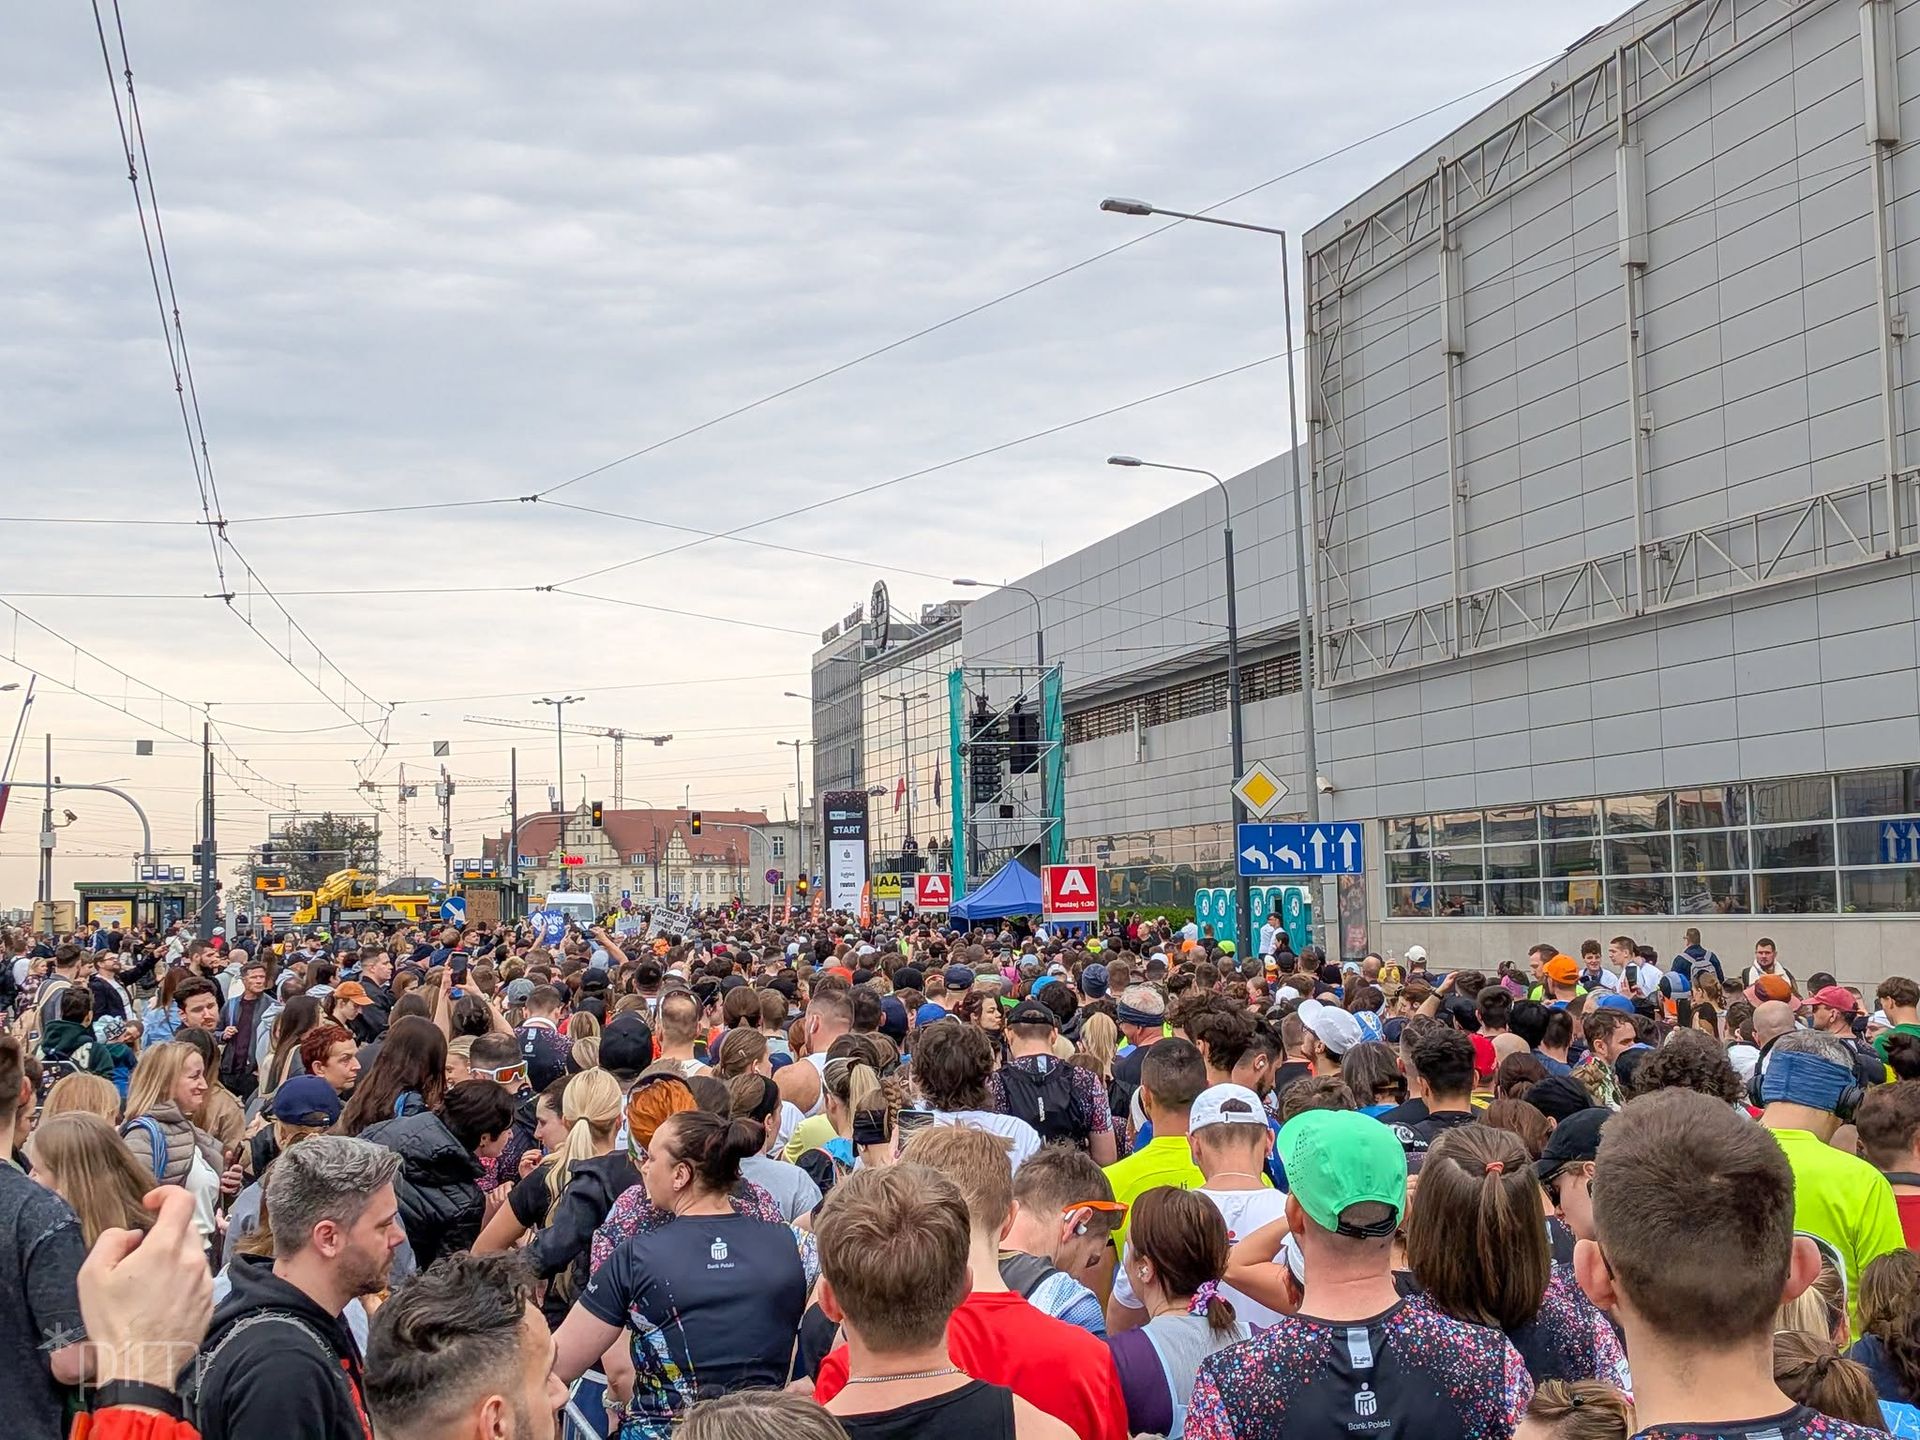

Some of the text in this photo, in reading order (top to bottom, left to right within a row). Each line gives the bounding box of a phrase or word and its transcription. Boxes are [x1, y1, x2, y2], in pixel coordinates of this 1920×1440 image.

[832, 825, 860, 834] START
[879, 875, 900, 887] AA
[924, 875, 946, 894] A
[1059, 869, 1091, 895] A
[1347, 1418, 1391, 1431] Bank Polski
